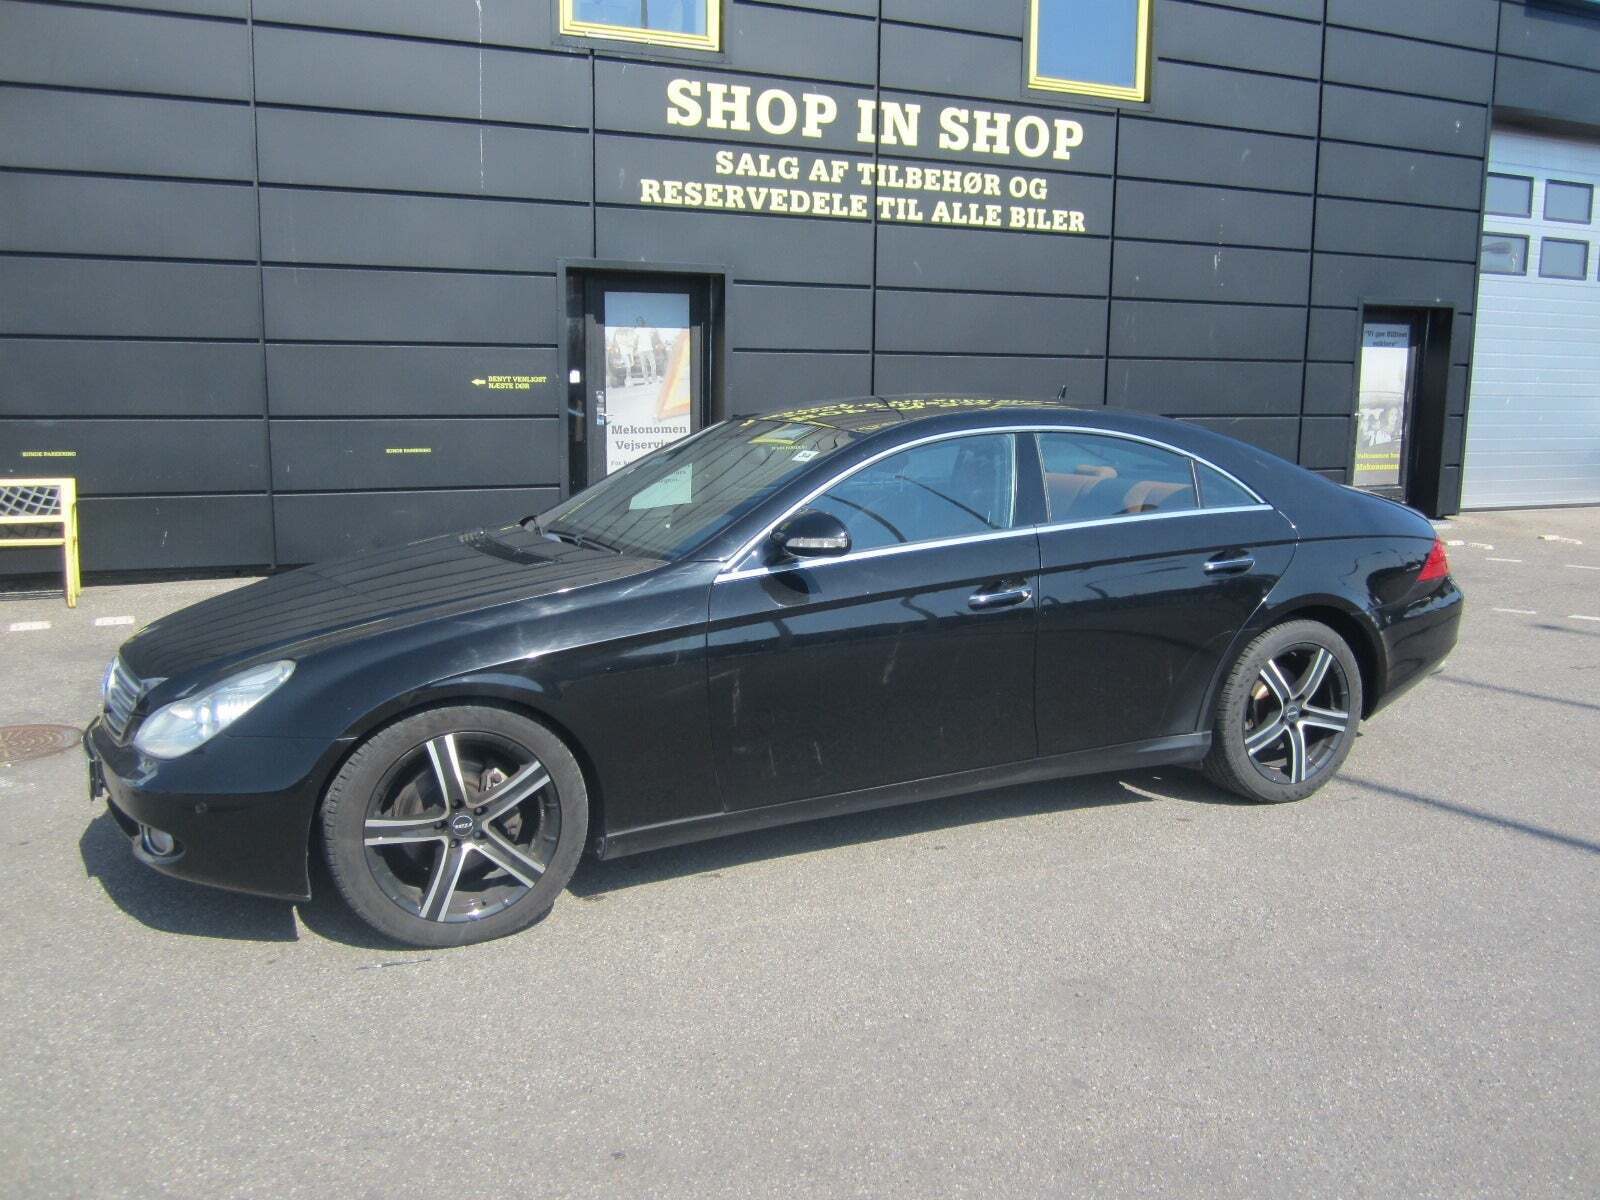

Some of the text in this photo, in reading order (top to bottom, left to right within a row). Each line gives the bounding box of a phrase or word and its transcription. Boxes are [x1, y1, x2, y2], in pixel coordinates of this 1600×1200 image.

[667, 78, 1084, 161] SHOP IN SHOP
[715, 150, 1048, 200] SALG AF TILBEHØR OG
[639, 179, 1086, 233] RESERVEDELE TIL ALLE BILER
[487, 375, 512, 383] BENYT
[611, 425, 687, 435] Mekonomen
